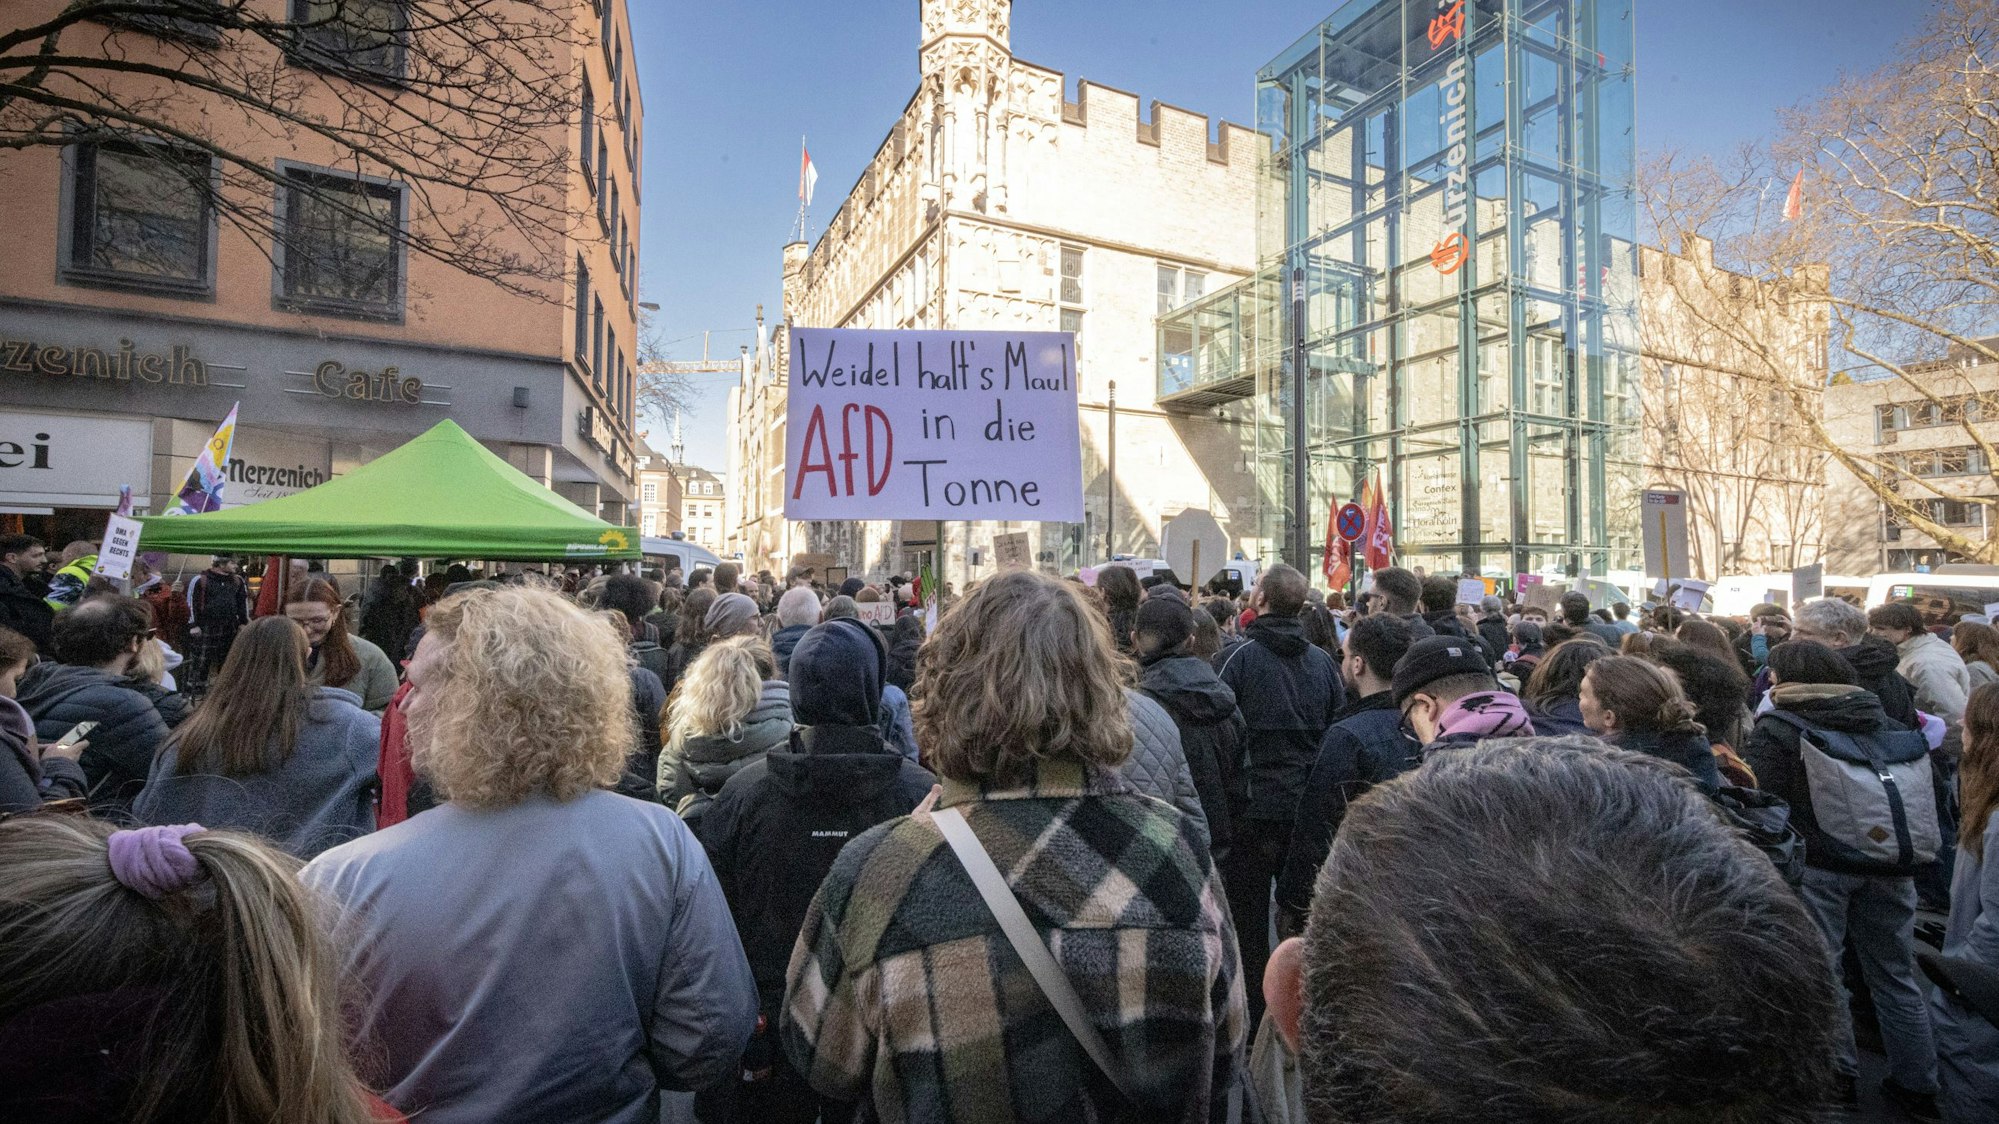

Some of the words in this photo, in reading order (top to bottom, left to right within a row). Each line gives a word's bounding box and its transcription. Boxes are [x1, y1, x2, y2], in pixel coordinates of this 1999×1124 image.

[0, 337, 208, 386] zenich
[314, 360, 422, 404] Cafe
[800, 338, 900, 388] Weidel
[917, 340, 994, 391] halt's
[1004, 341, 1068, 392] Maul
[792, 402, 894, 499] AfD
[922, 408, 955, 440] in
[984, 399, 1036, 441] die
[903, 459, 1041, 507] Tonne
[1424, 485, 1456, 494] Confex
[109, 547, 129, 557] RECHTS
[112, 537, 128, 547] GEGEN
